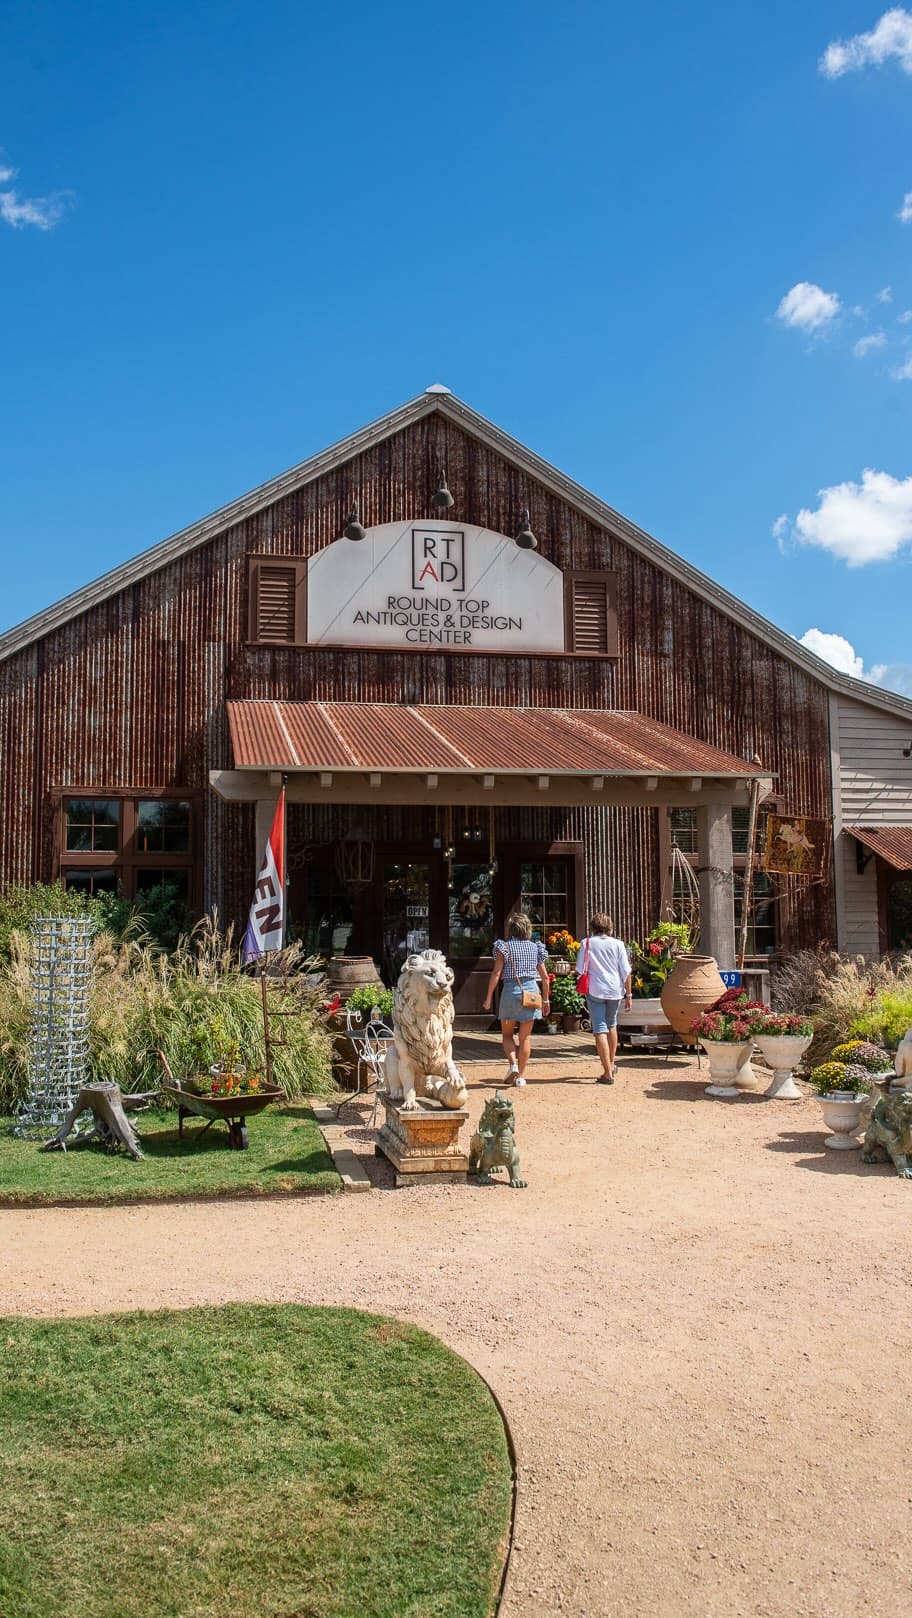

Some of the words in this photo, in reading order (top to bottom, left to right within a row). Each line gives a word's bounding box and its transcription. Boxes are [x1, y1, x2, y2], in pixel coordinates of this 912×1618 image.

[387, 596, 451, 612] ROUND
[457, 599, 490, 613] TOP
[353, 611, 439, 628] ANTIQUES
[444, 615, 456, 628] &
[460, 616, 522, 631] DESIGN
[405, 629, 472, 644] CENTER
[408, 907, 427, 916] OPEN
